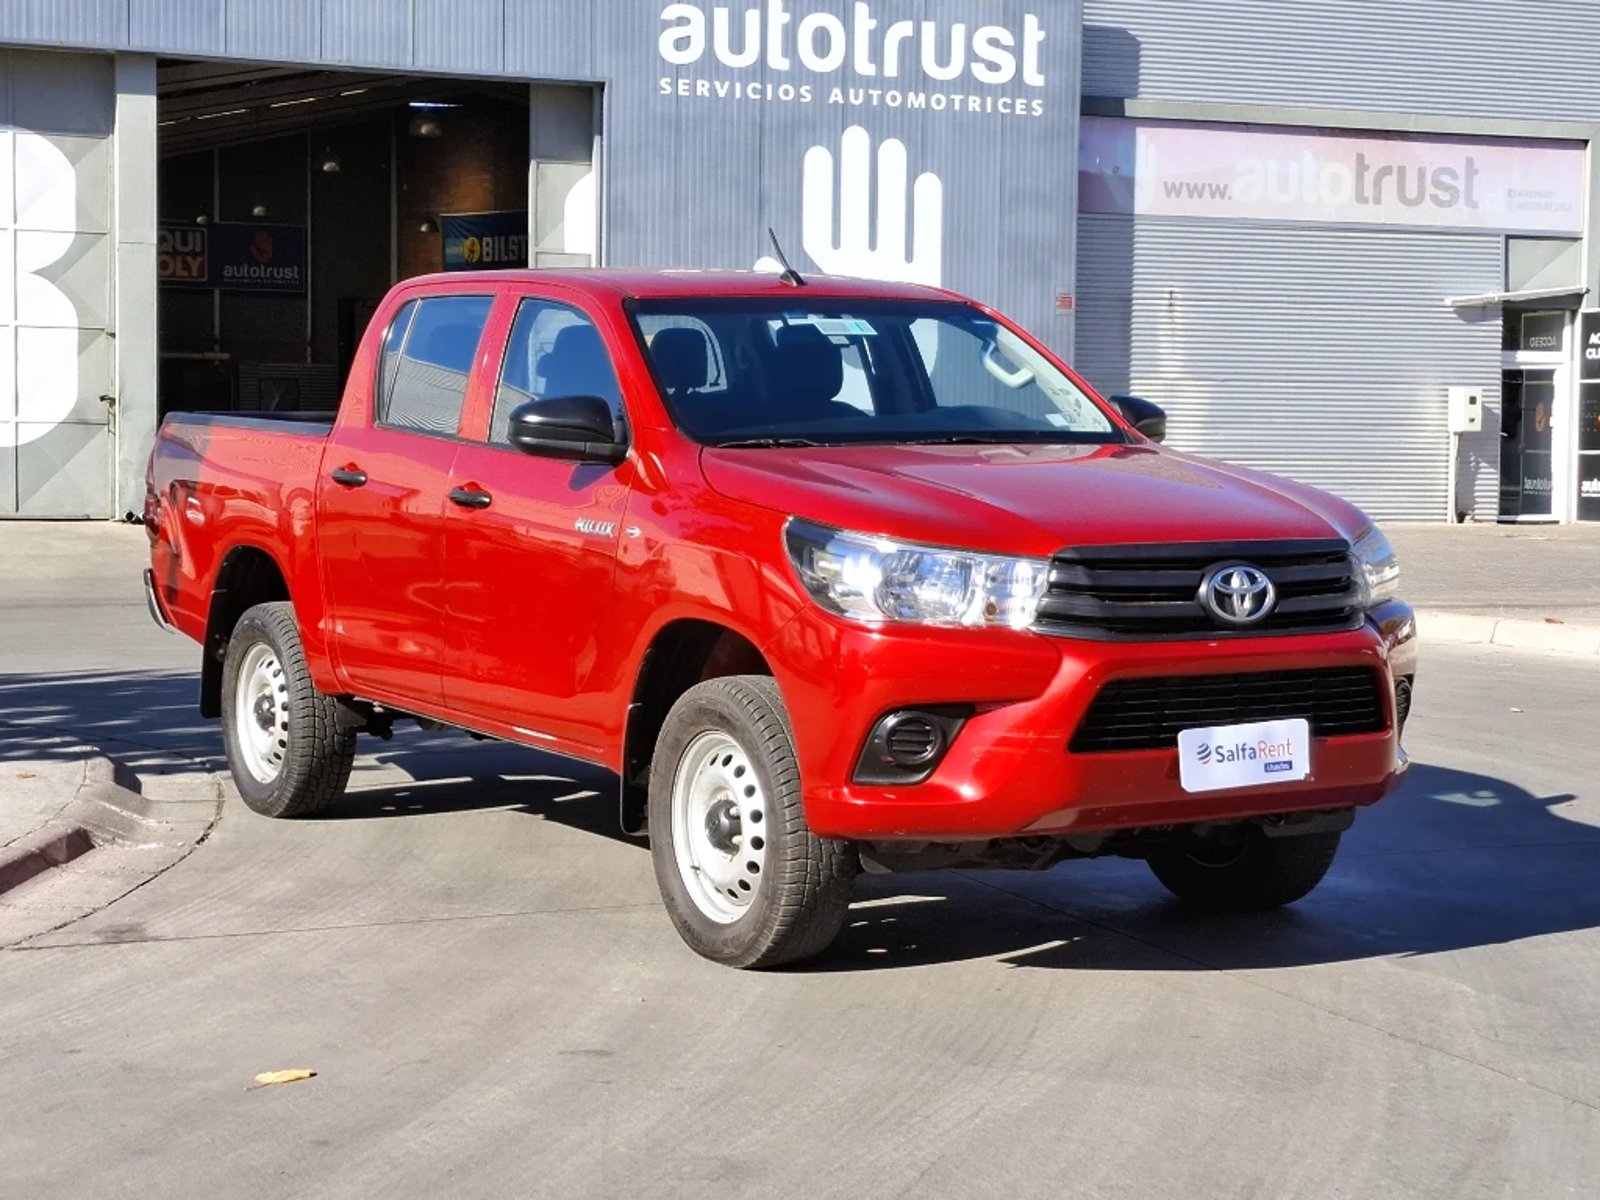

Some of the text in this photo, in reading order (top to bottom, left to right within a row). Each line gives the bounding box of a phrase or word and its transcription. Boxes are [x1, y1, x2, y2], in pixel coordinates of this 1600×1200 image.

[658, 0, 1046, 86] autotrust
[659, 77, 1044, 117] SERVICIOS AUTOMOTRICES
[482, 234, 528, 262] BILST
[223, 263, 300, 279] autotrust
[574, 517, 615, 538] HILUX
[1215, 738, 1293, 763] SalfaRent
